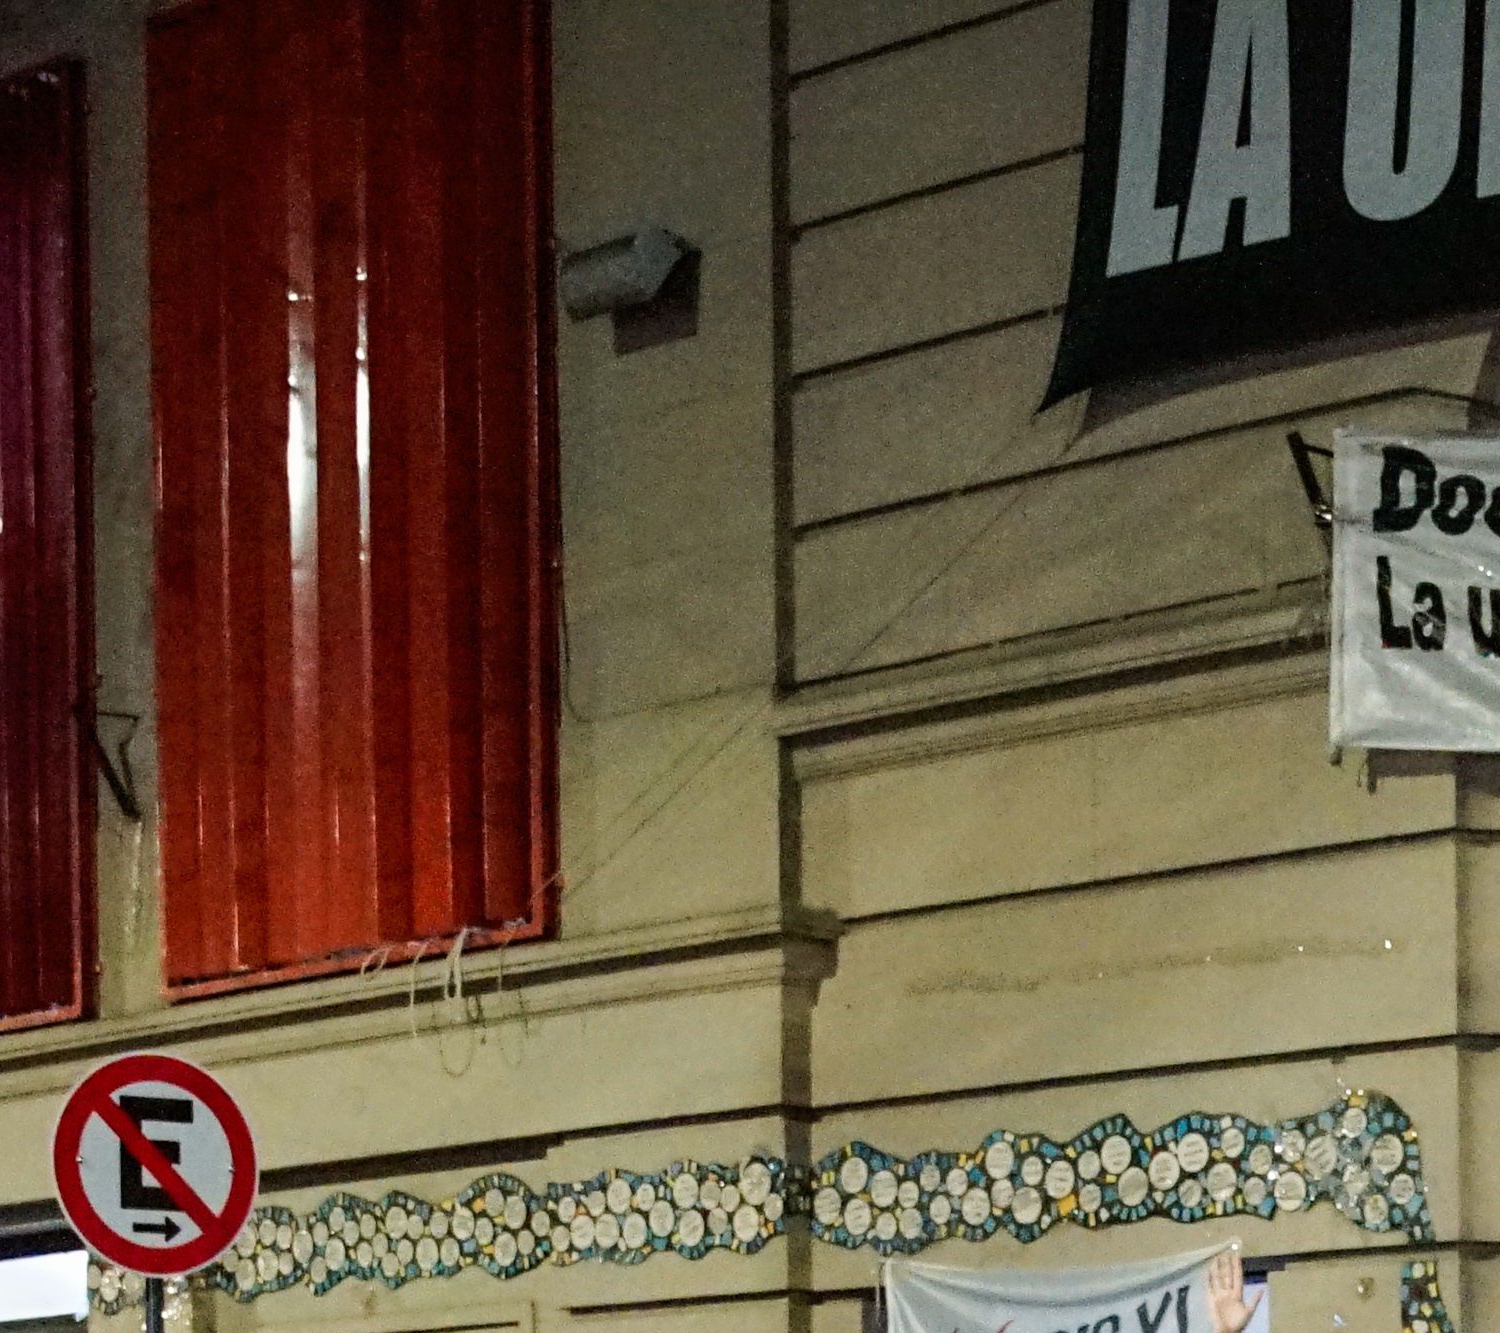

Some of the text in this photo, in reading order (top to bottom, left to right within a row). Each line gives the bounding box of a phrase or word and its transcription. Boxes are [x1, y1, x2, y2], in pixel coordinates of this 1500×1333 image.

[1106, 0, 1291, 278] LA
[1375, 556, 1447, 651] La
[119, 1095, 194, 1212] E
